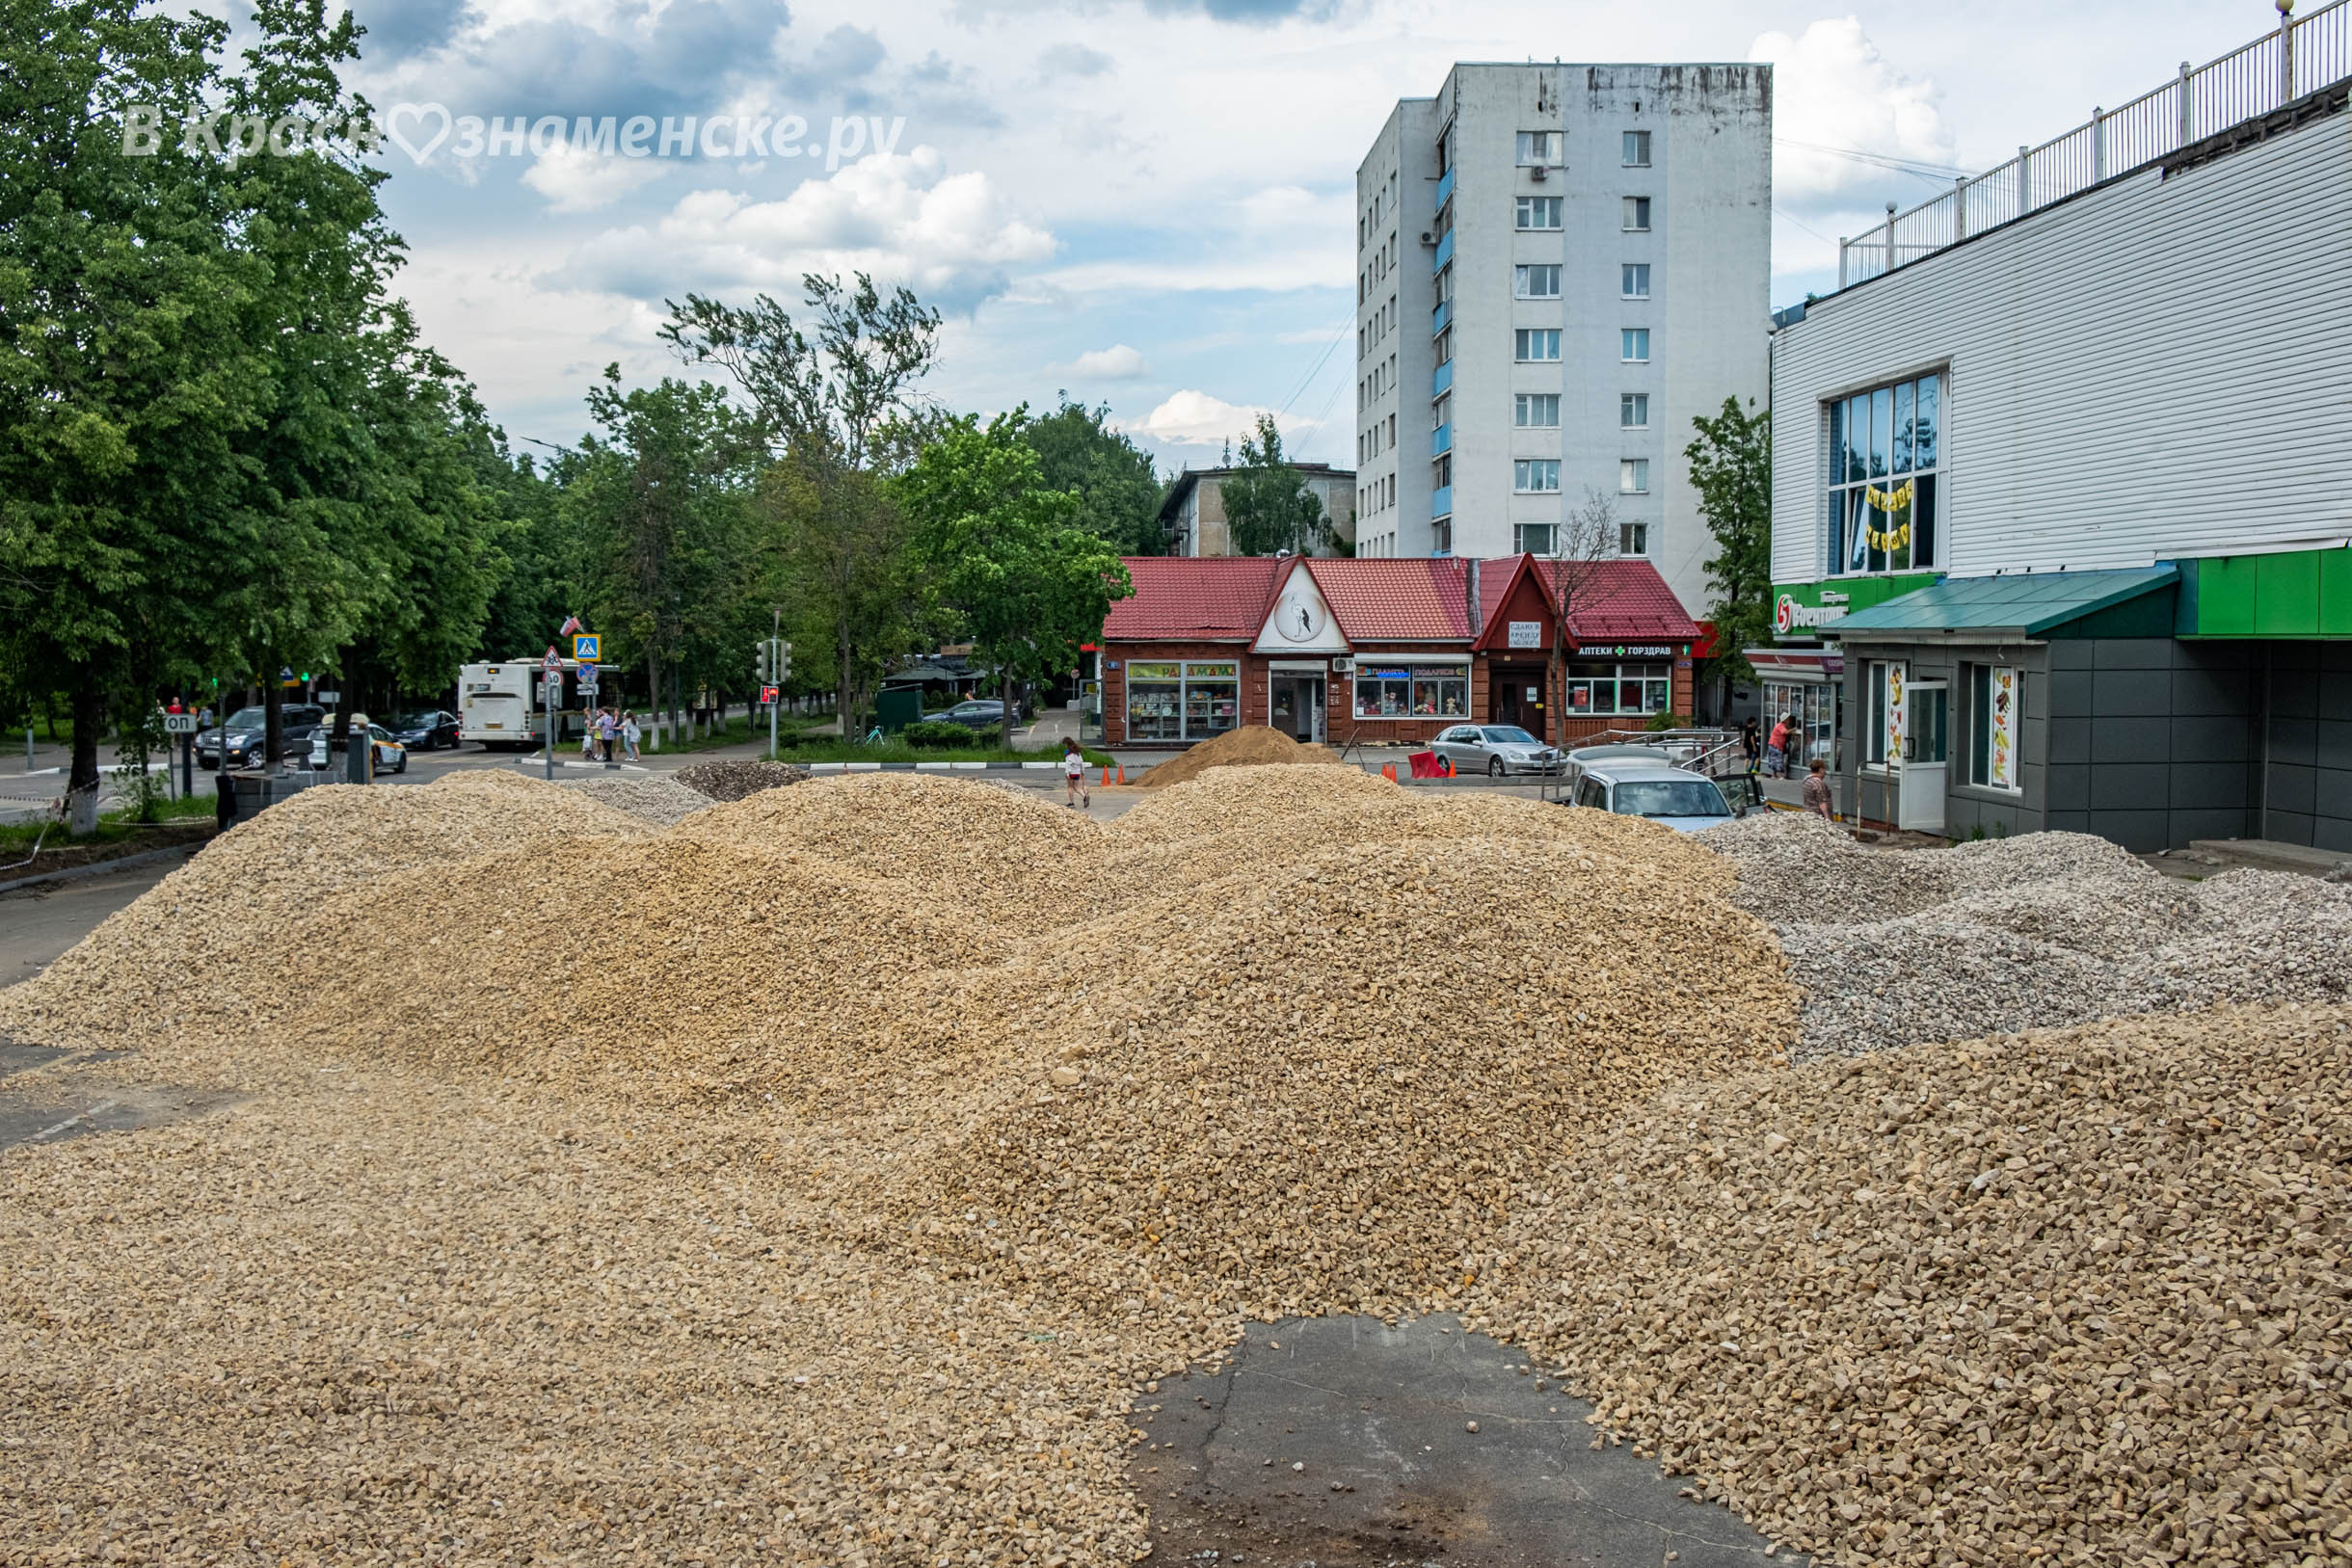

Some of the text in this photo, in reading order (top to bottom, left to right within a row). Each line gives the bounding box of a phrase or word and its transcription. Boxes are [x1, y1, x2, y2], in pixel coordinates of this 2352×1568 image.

[1579, 647, 1671, 656] АПТЕКИ ГОРЗДРАВ
[168, 717, 189, 730] ОП
